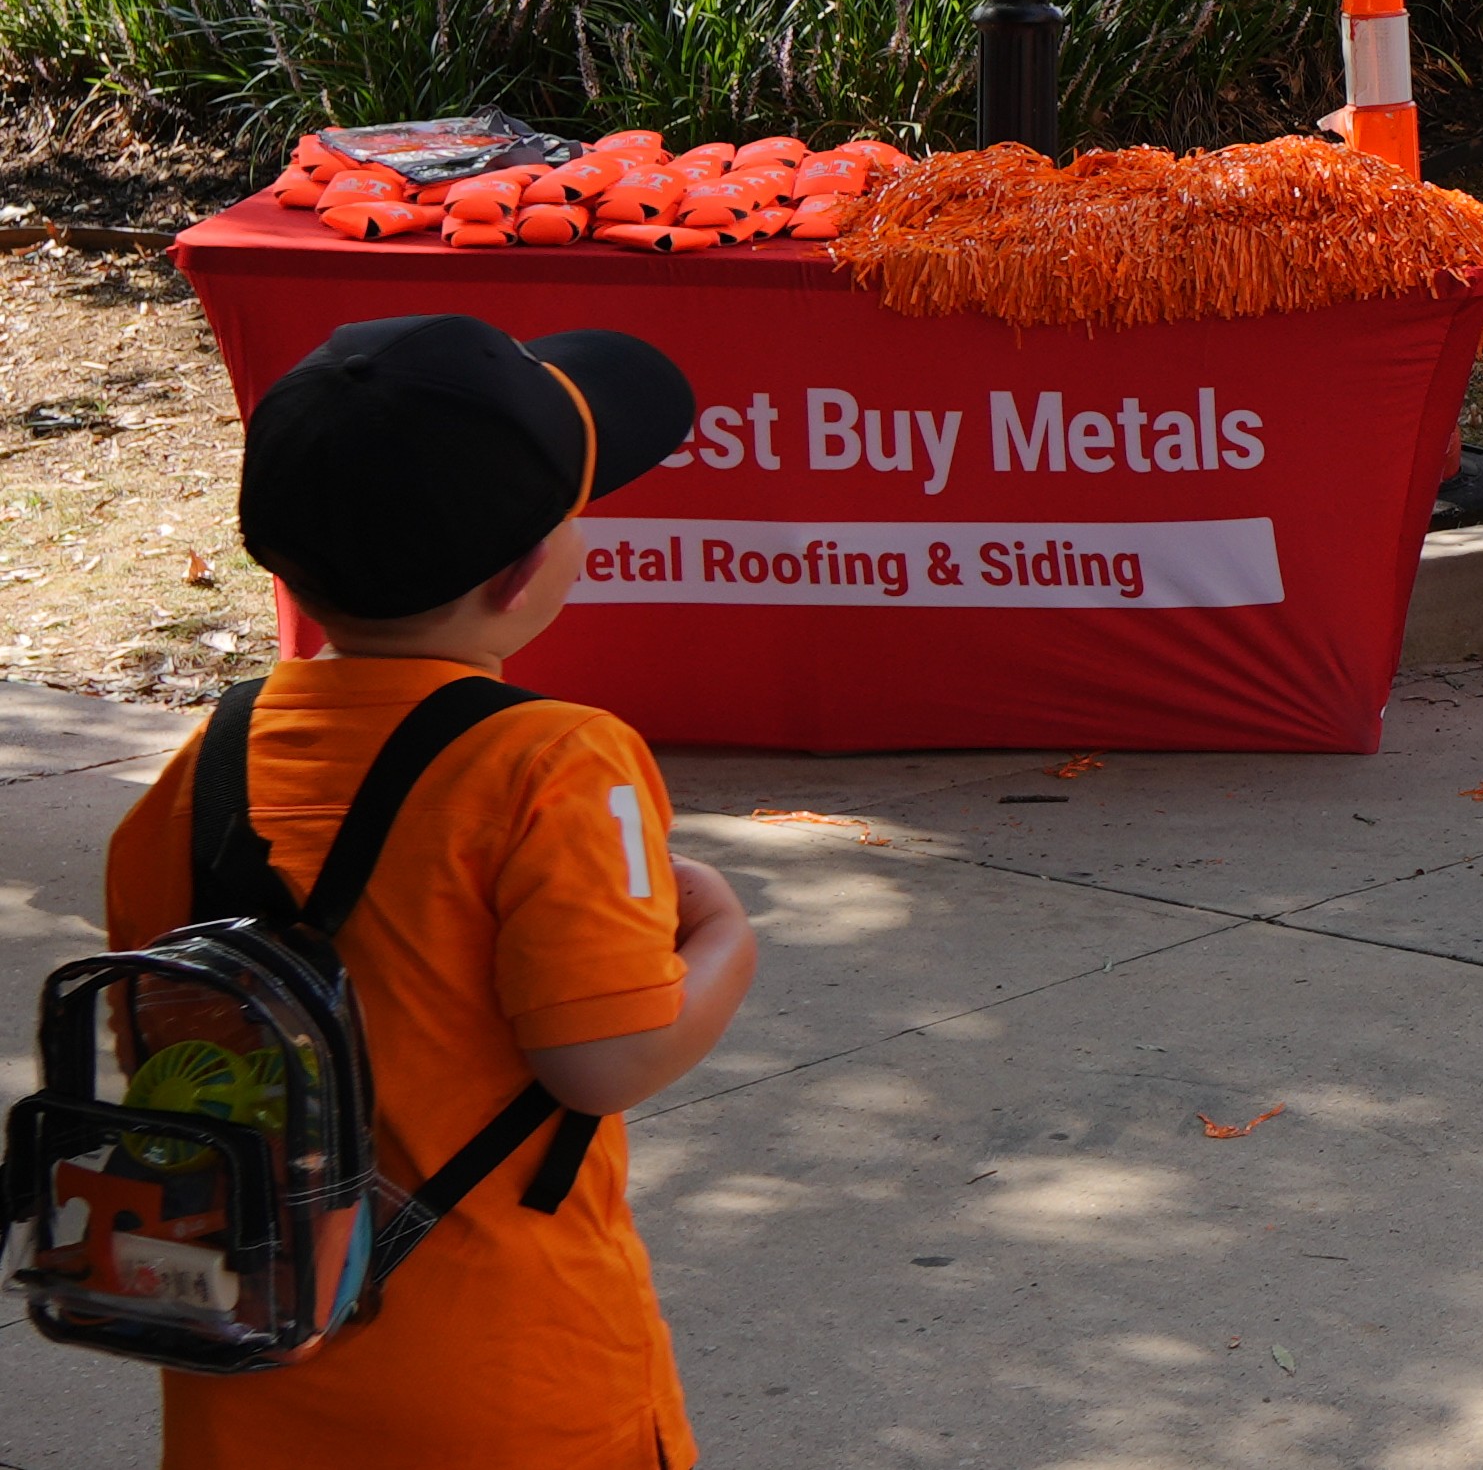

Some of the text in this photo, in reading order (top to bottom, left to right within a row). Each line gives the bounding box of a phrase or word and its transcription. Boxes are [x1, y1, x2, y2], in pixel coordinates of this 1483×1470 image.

[658, 387, 1265, 496] st Buy Metals
[577, 536, 1144, 599] etal Roofing & Siding
[608, 784, 652, 898] 1
